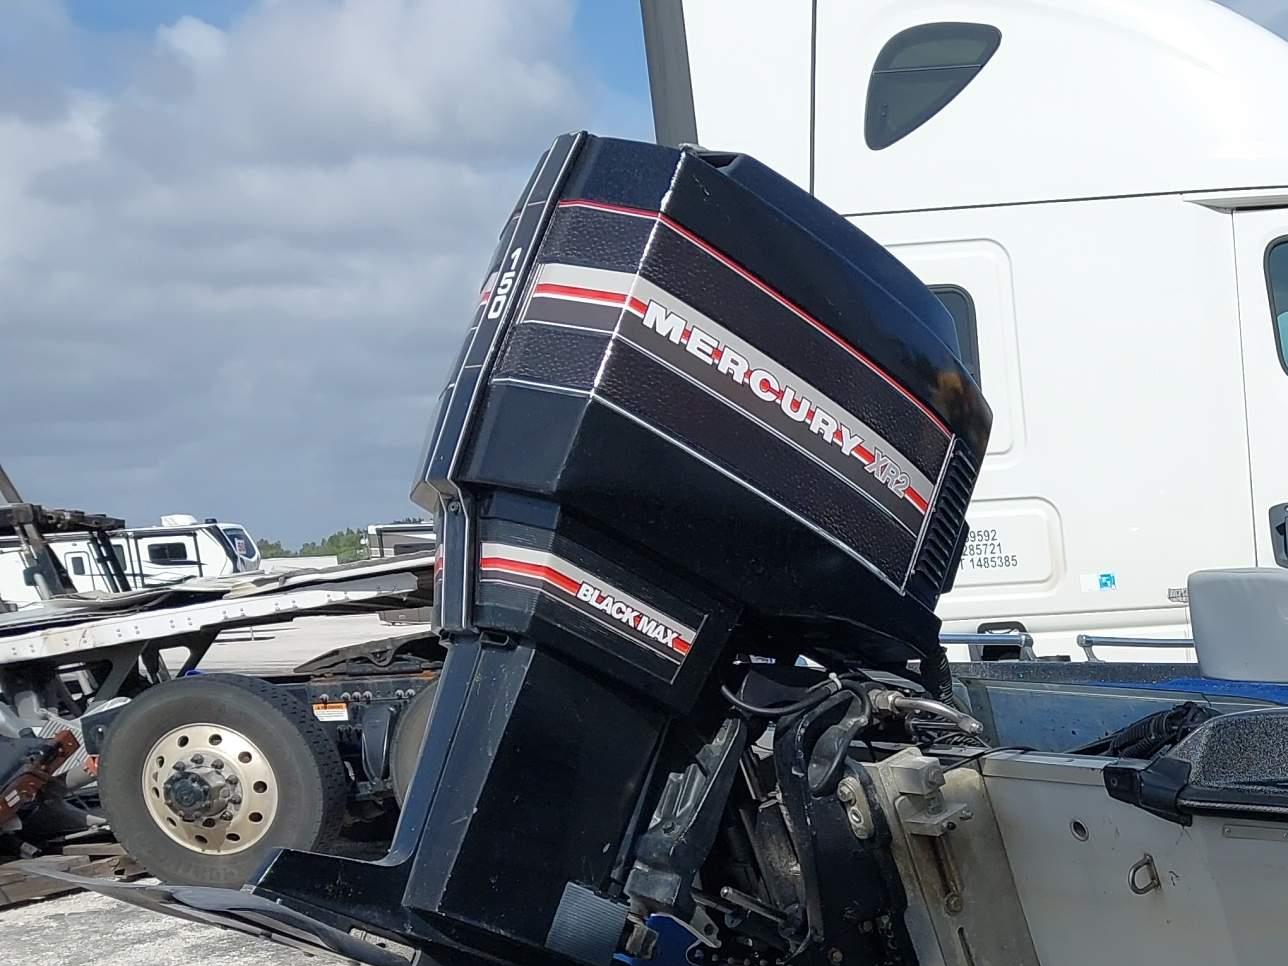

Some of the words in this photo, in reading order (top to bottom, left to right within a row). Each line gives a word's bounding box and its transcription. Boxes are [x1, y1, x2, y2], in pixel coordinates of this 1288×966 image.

[642, 300, 864, 457] MERCURY
[863, 447, 911, 498] XR2
[969, 554, 1018, 569] 1485385
[576, 581, 641, 629] BLACK
[635, 614, 680, 649] MAX
